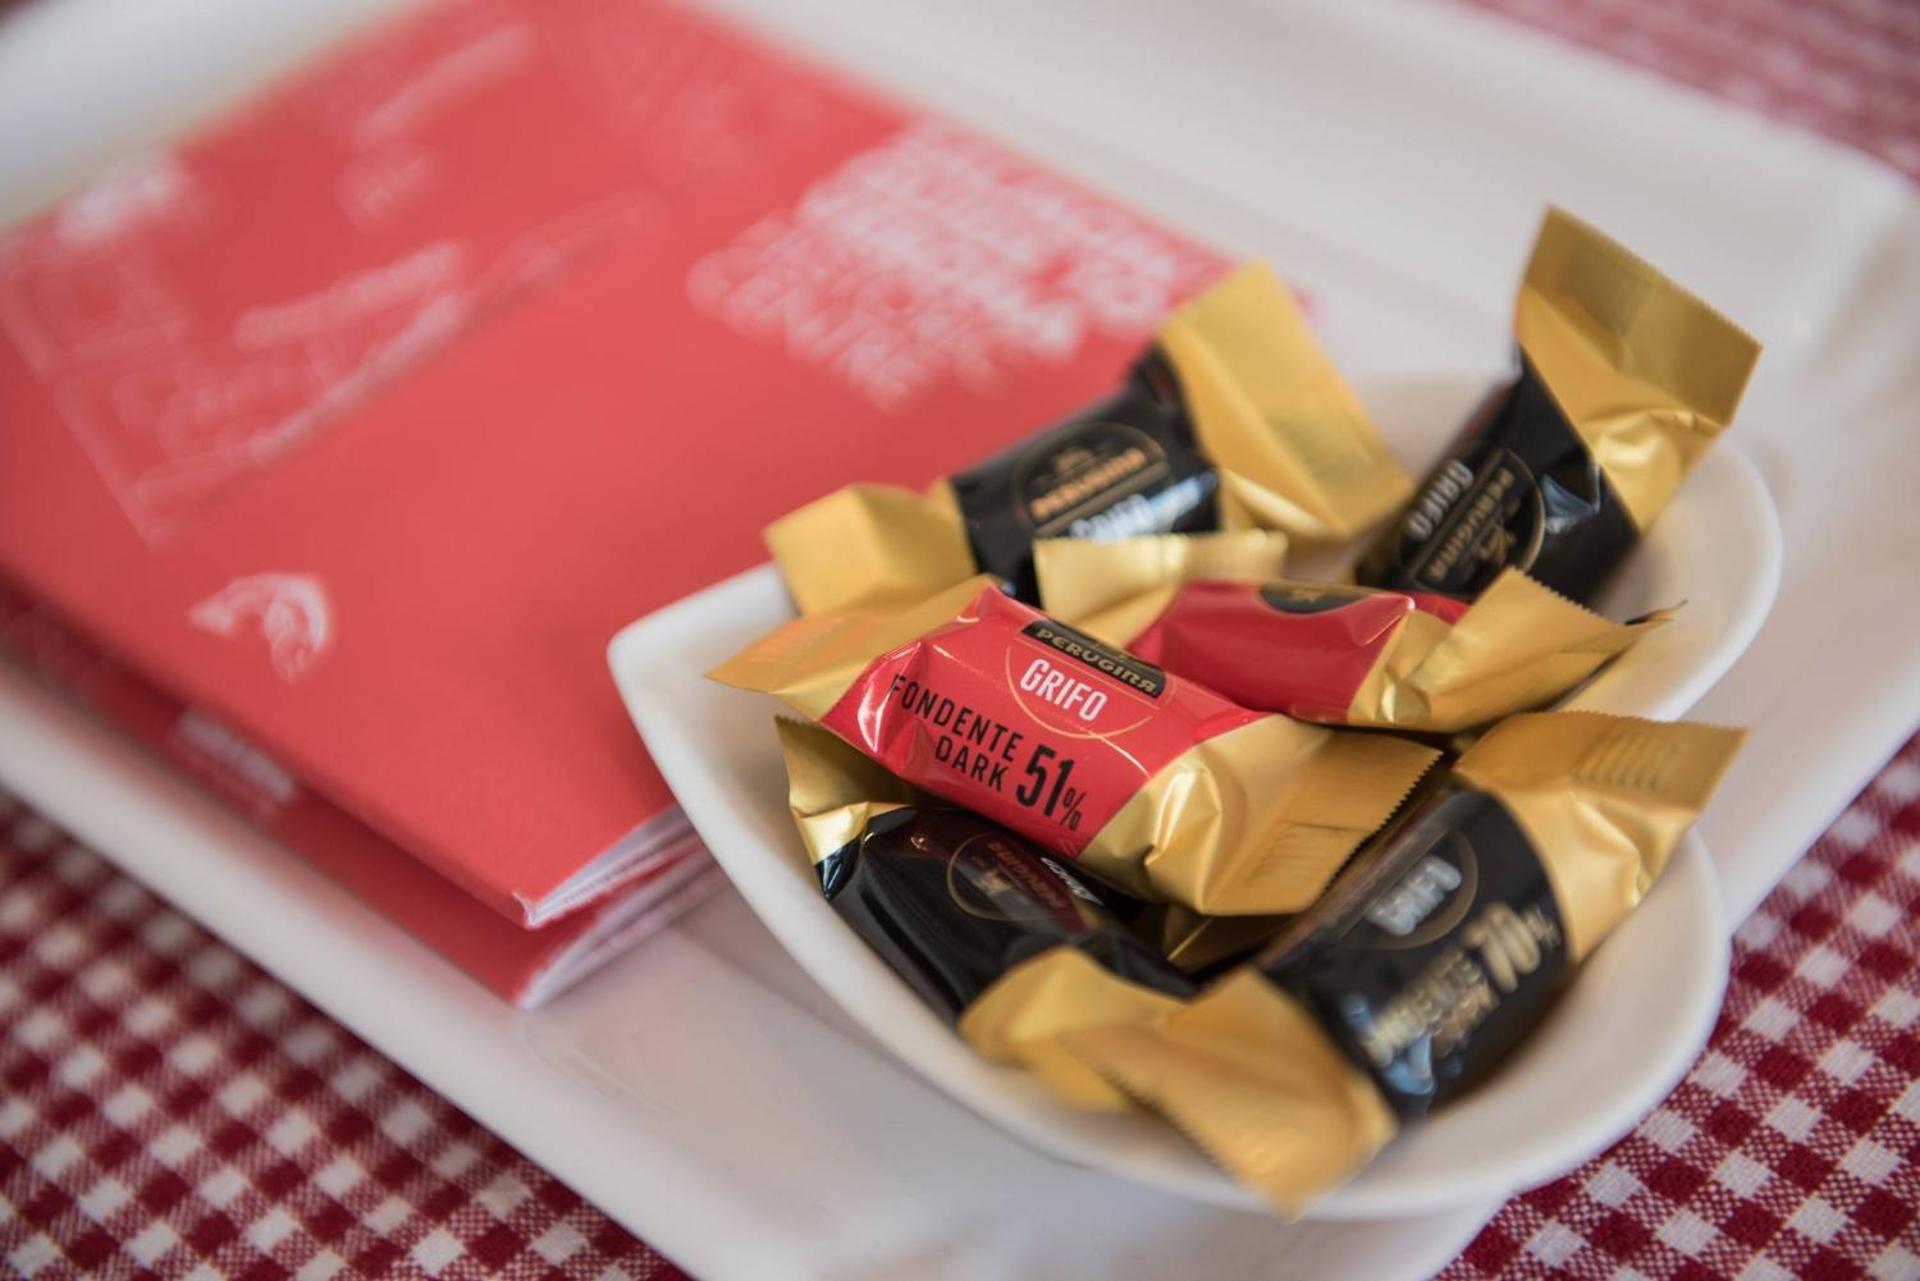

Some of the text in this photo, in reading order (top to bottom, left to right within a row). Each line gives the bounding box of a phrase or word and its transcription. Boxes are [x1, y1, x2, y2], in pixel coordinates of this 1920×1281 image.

[1020, 658, 1108, 721] GRIFO
[1037, 628, 1157, 693] PERUGINA
[891, 675, 1025, 762] FONDENTE
[935, 735, 1087, 831] DARK 51%
